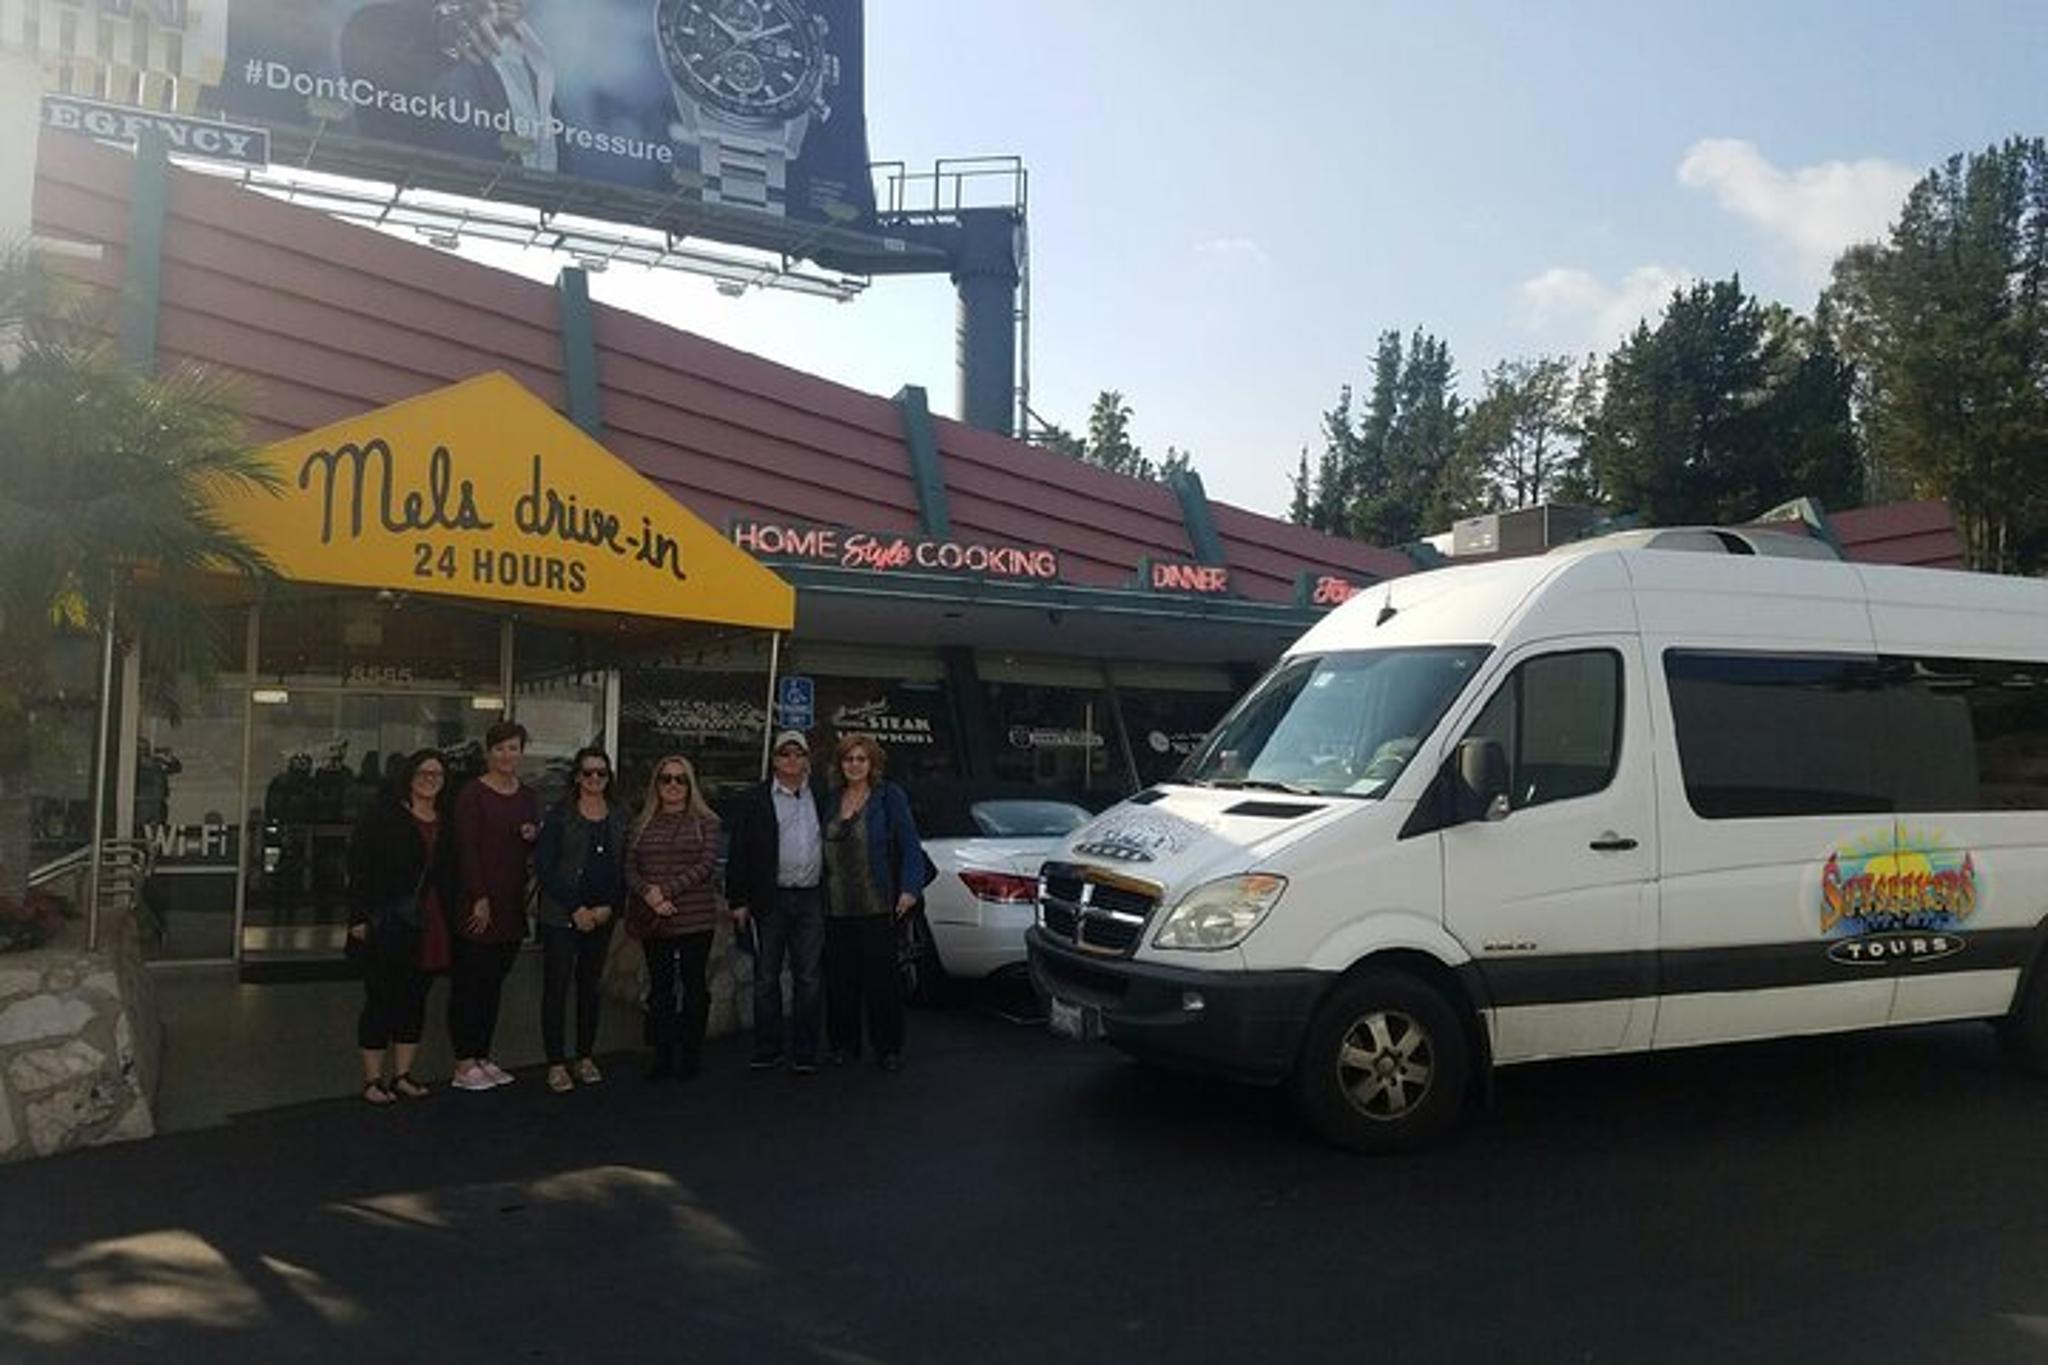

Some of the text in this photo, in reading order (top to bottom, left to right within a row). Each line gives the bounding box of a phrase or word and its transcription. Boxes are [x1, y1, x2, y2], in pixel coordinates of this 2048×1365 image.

[244, 58, 674, 164] #DontCrackUnderPressure
[299, 438, 687, 580] Mels drive-in
[414, 542, 588, 593] 24 HOURS
[735, 523, 1057, 578] HOME Style COOKING
[1151, 563, 1229, 593] DINNER
[143, 823, 228, 857] Wi-Fi
[1848, 937, 1949, 959] TOURS
